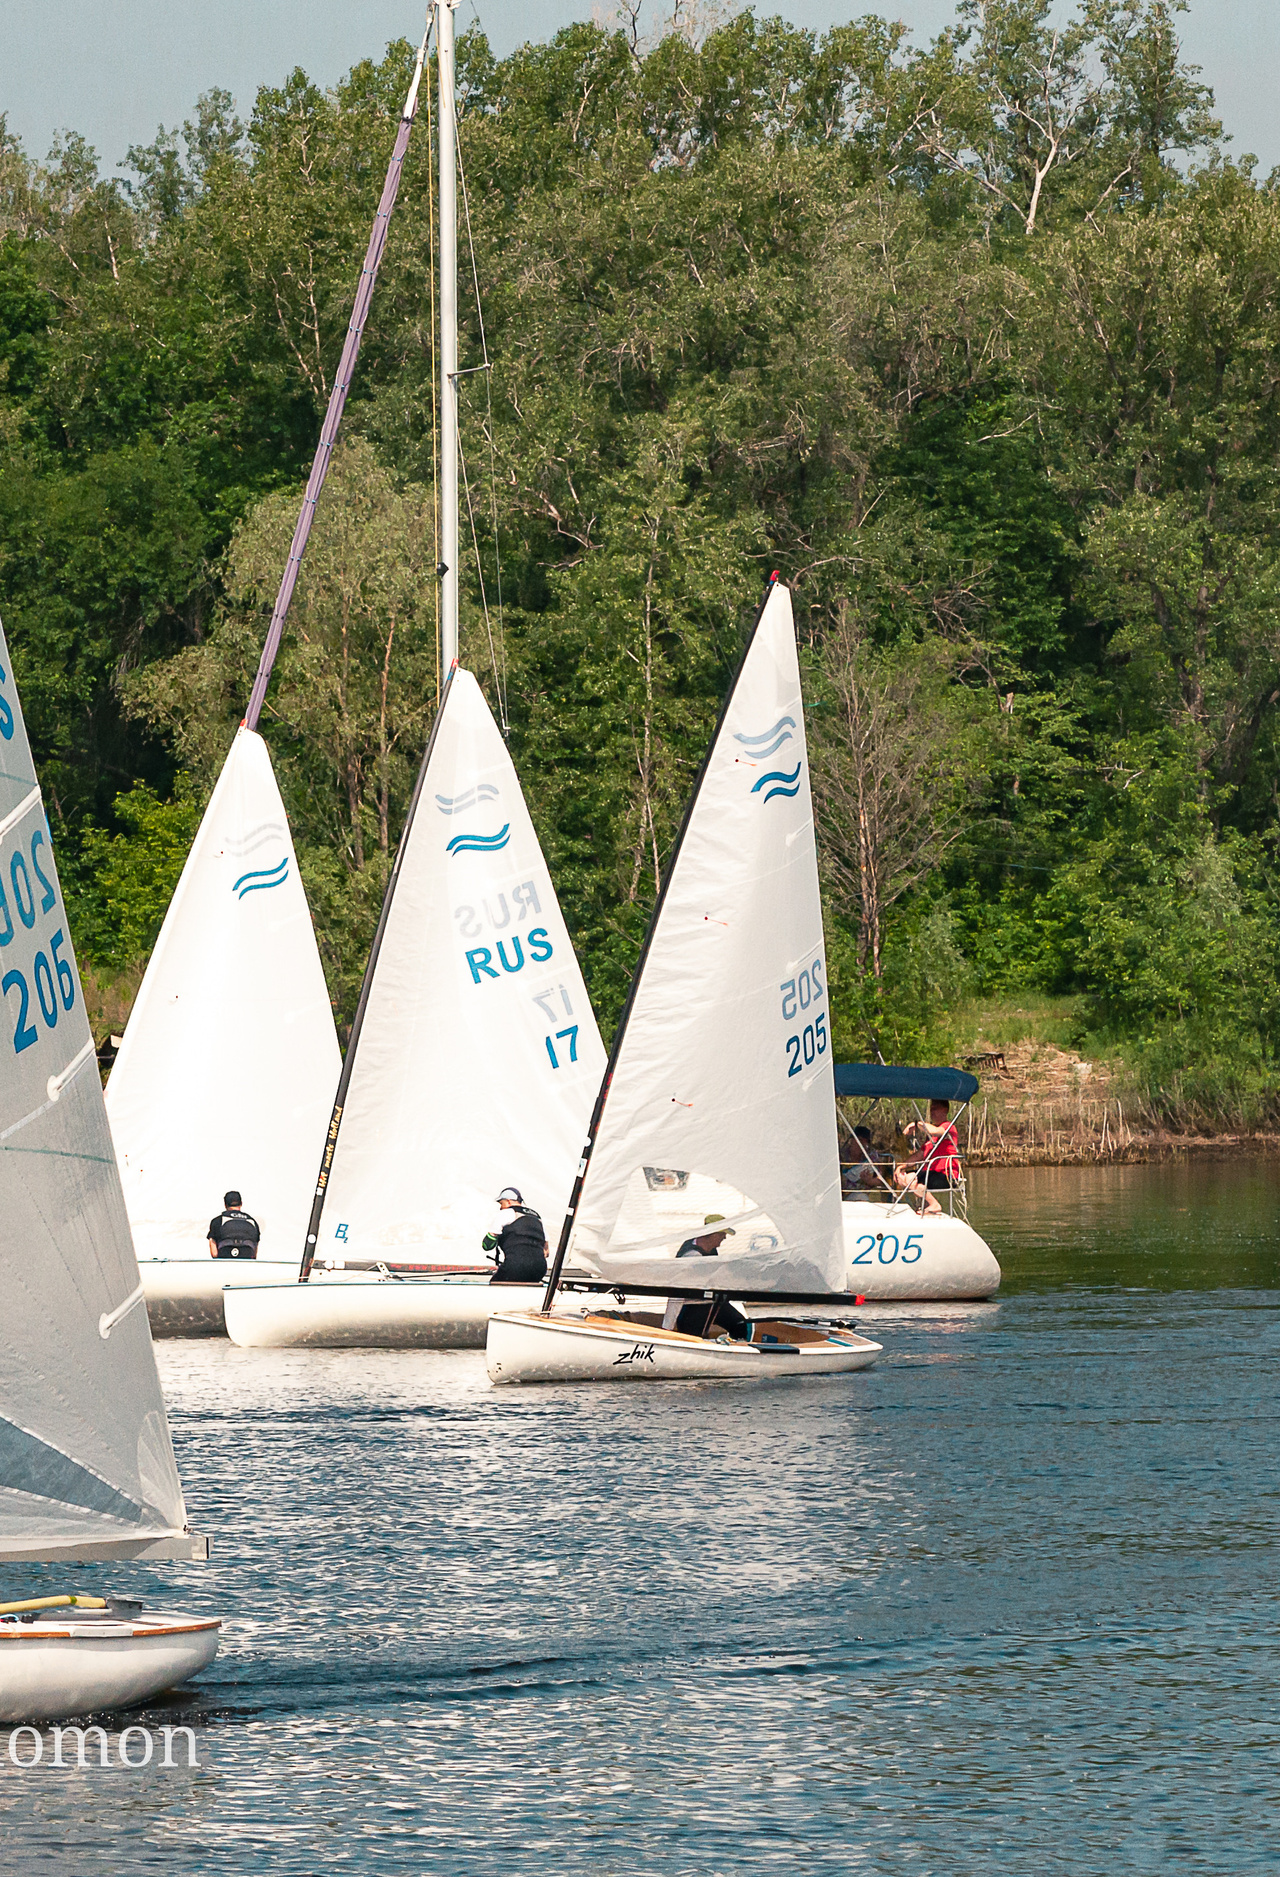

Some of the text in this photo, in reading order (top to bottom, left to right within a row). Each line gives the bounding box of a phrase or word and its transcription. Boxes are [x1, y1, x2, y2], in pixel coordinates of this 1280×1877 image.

[465, 928, 554, 984] RUS
[545, 1025, 579, 1069] 17
[786, 1012, 827, 1078] 205
[852, 1233, 924, 1265] 205
[612, 1344, 655, 1365] zhik
